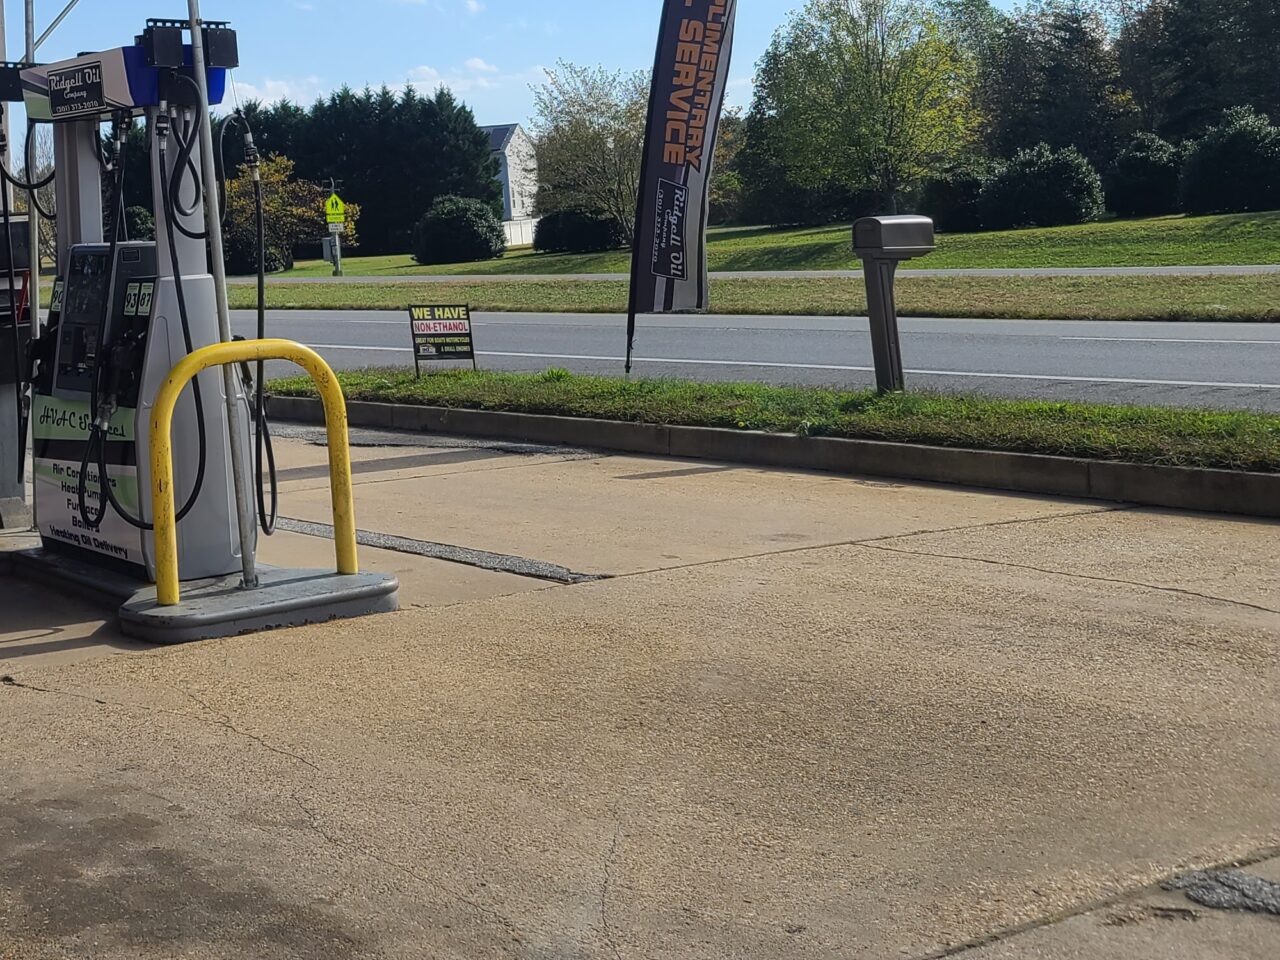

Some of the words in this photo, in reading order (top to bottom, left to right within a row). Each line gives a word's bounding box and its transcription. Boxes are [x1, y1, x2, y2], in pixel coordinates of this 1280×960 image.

[49, 72, 83, 91] Ridgell
[84, 68, 101, 83] Oil
[663, 18, 704, 166] SERVICE
[670, 189, 685, 246] Ridgell
[670, 251, 682, 276] Oil
[126, 292, 137, 309] 93
[139, 292, 151, 308] 87
[411, 307, 432, 319] WE
[434, 307, 467, 319] HAVE
[414, 321, 468, 332] NON-ETHANOL
[39, 405, 77, 429] HVAC
[52, 462, 65, 475] Air
[49, 524, 81, 546] Heating
[81, 534, 92, 546] Oil
[92, 538, 128, 559] Delivery
